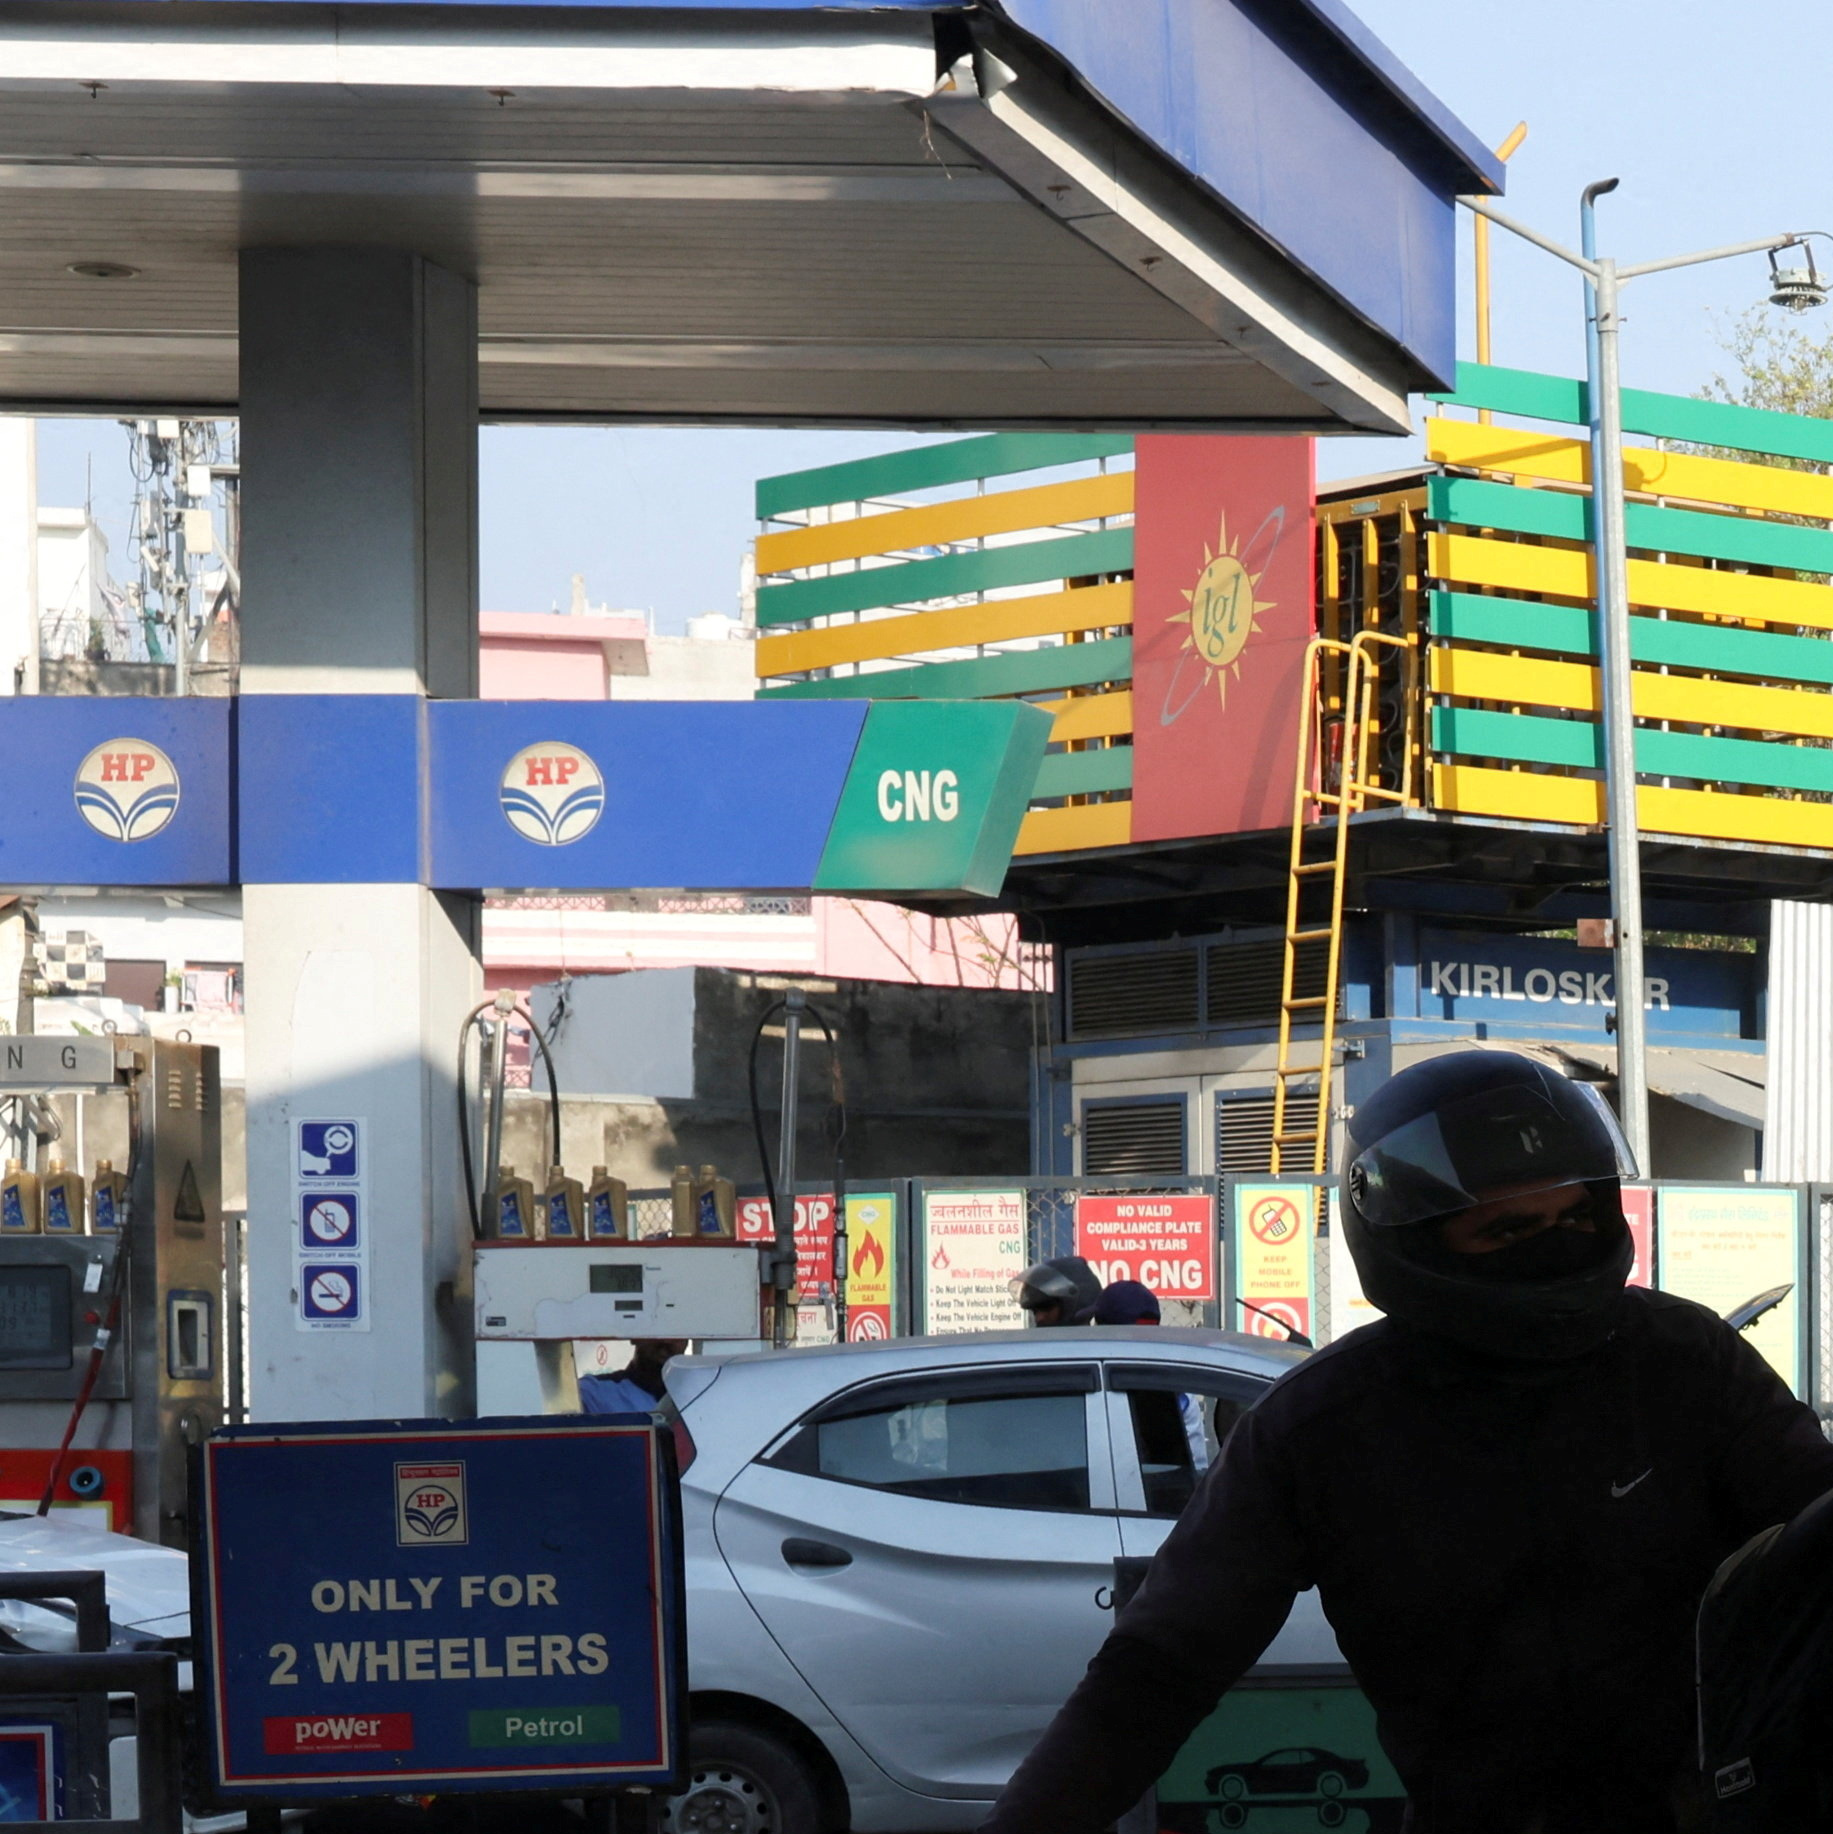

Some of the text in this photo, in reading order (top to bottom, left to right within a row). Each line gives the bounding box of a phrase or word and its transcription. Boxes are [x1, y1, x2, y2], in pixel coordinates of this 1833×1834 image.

[100, 754, 155, 783] HP
[525, 756, 580, 786] HP
[877, 769, 959, 823] CNG
[1429, 961, 1670, 1011] KIRLOSKR
[998, 1196, 1020, 1218] गैस
[1117, 1205, 1173, 1217] NO VALID
[930, 1223, 1020, 1235] FLAMMABLE GAS
[1086, 1221, 1202, 1234] COMPLIANCE PLATE
[999, 1241, 1021, 1254] CNG
[1102, 1239, 1188, 1251] VALID-3 YEARS
[1263, 1255, 1287, 1263] KEEP
[1088, 1259, 1203, 1290] NO CNG
[1258, 1267, 1292, 1276] MOBILE
[850, 1283, 886, 1292] FLAMMABLE
[416, 1493, 446, 1508] HP
[311, 1573, 559, 1614] ONLY FOR
[268, 1633, 609, 1686] 2 WHEELERS
[505, 1715, 583, 1738] Petrol
